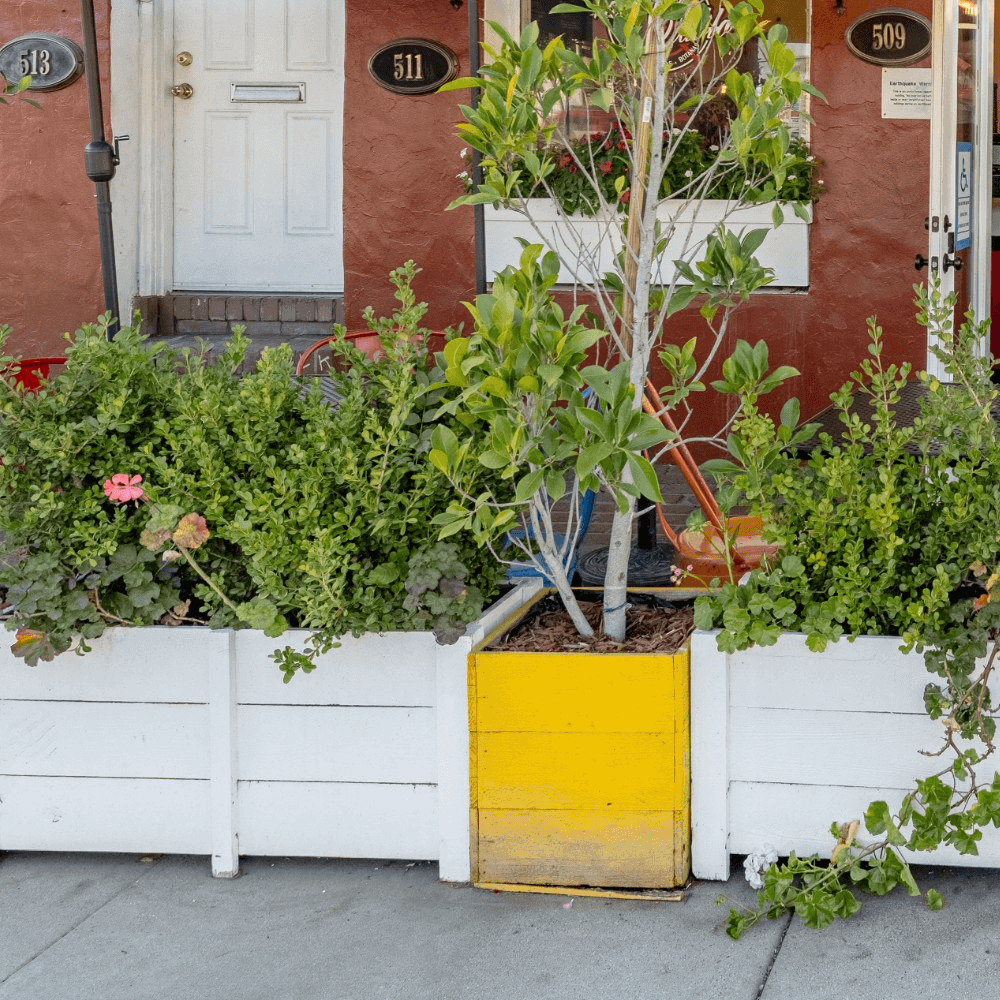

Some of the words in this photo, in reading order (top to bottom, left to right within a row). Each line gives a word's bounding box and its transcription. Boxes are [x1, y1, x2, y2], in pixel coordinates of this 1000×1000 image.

[872, 22, 906, 50] 509
[20, 49, 50, 75] 513
[393, 53, 423, 80] 511
